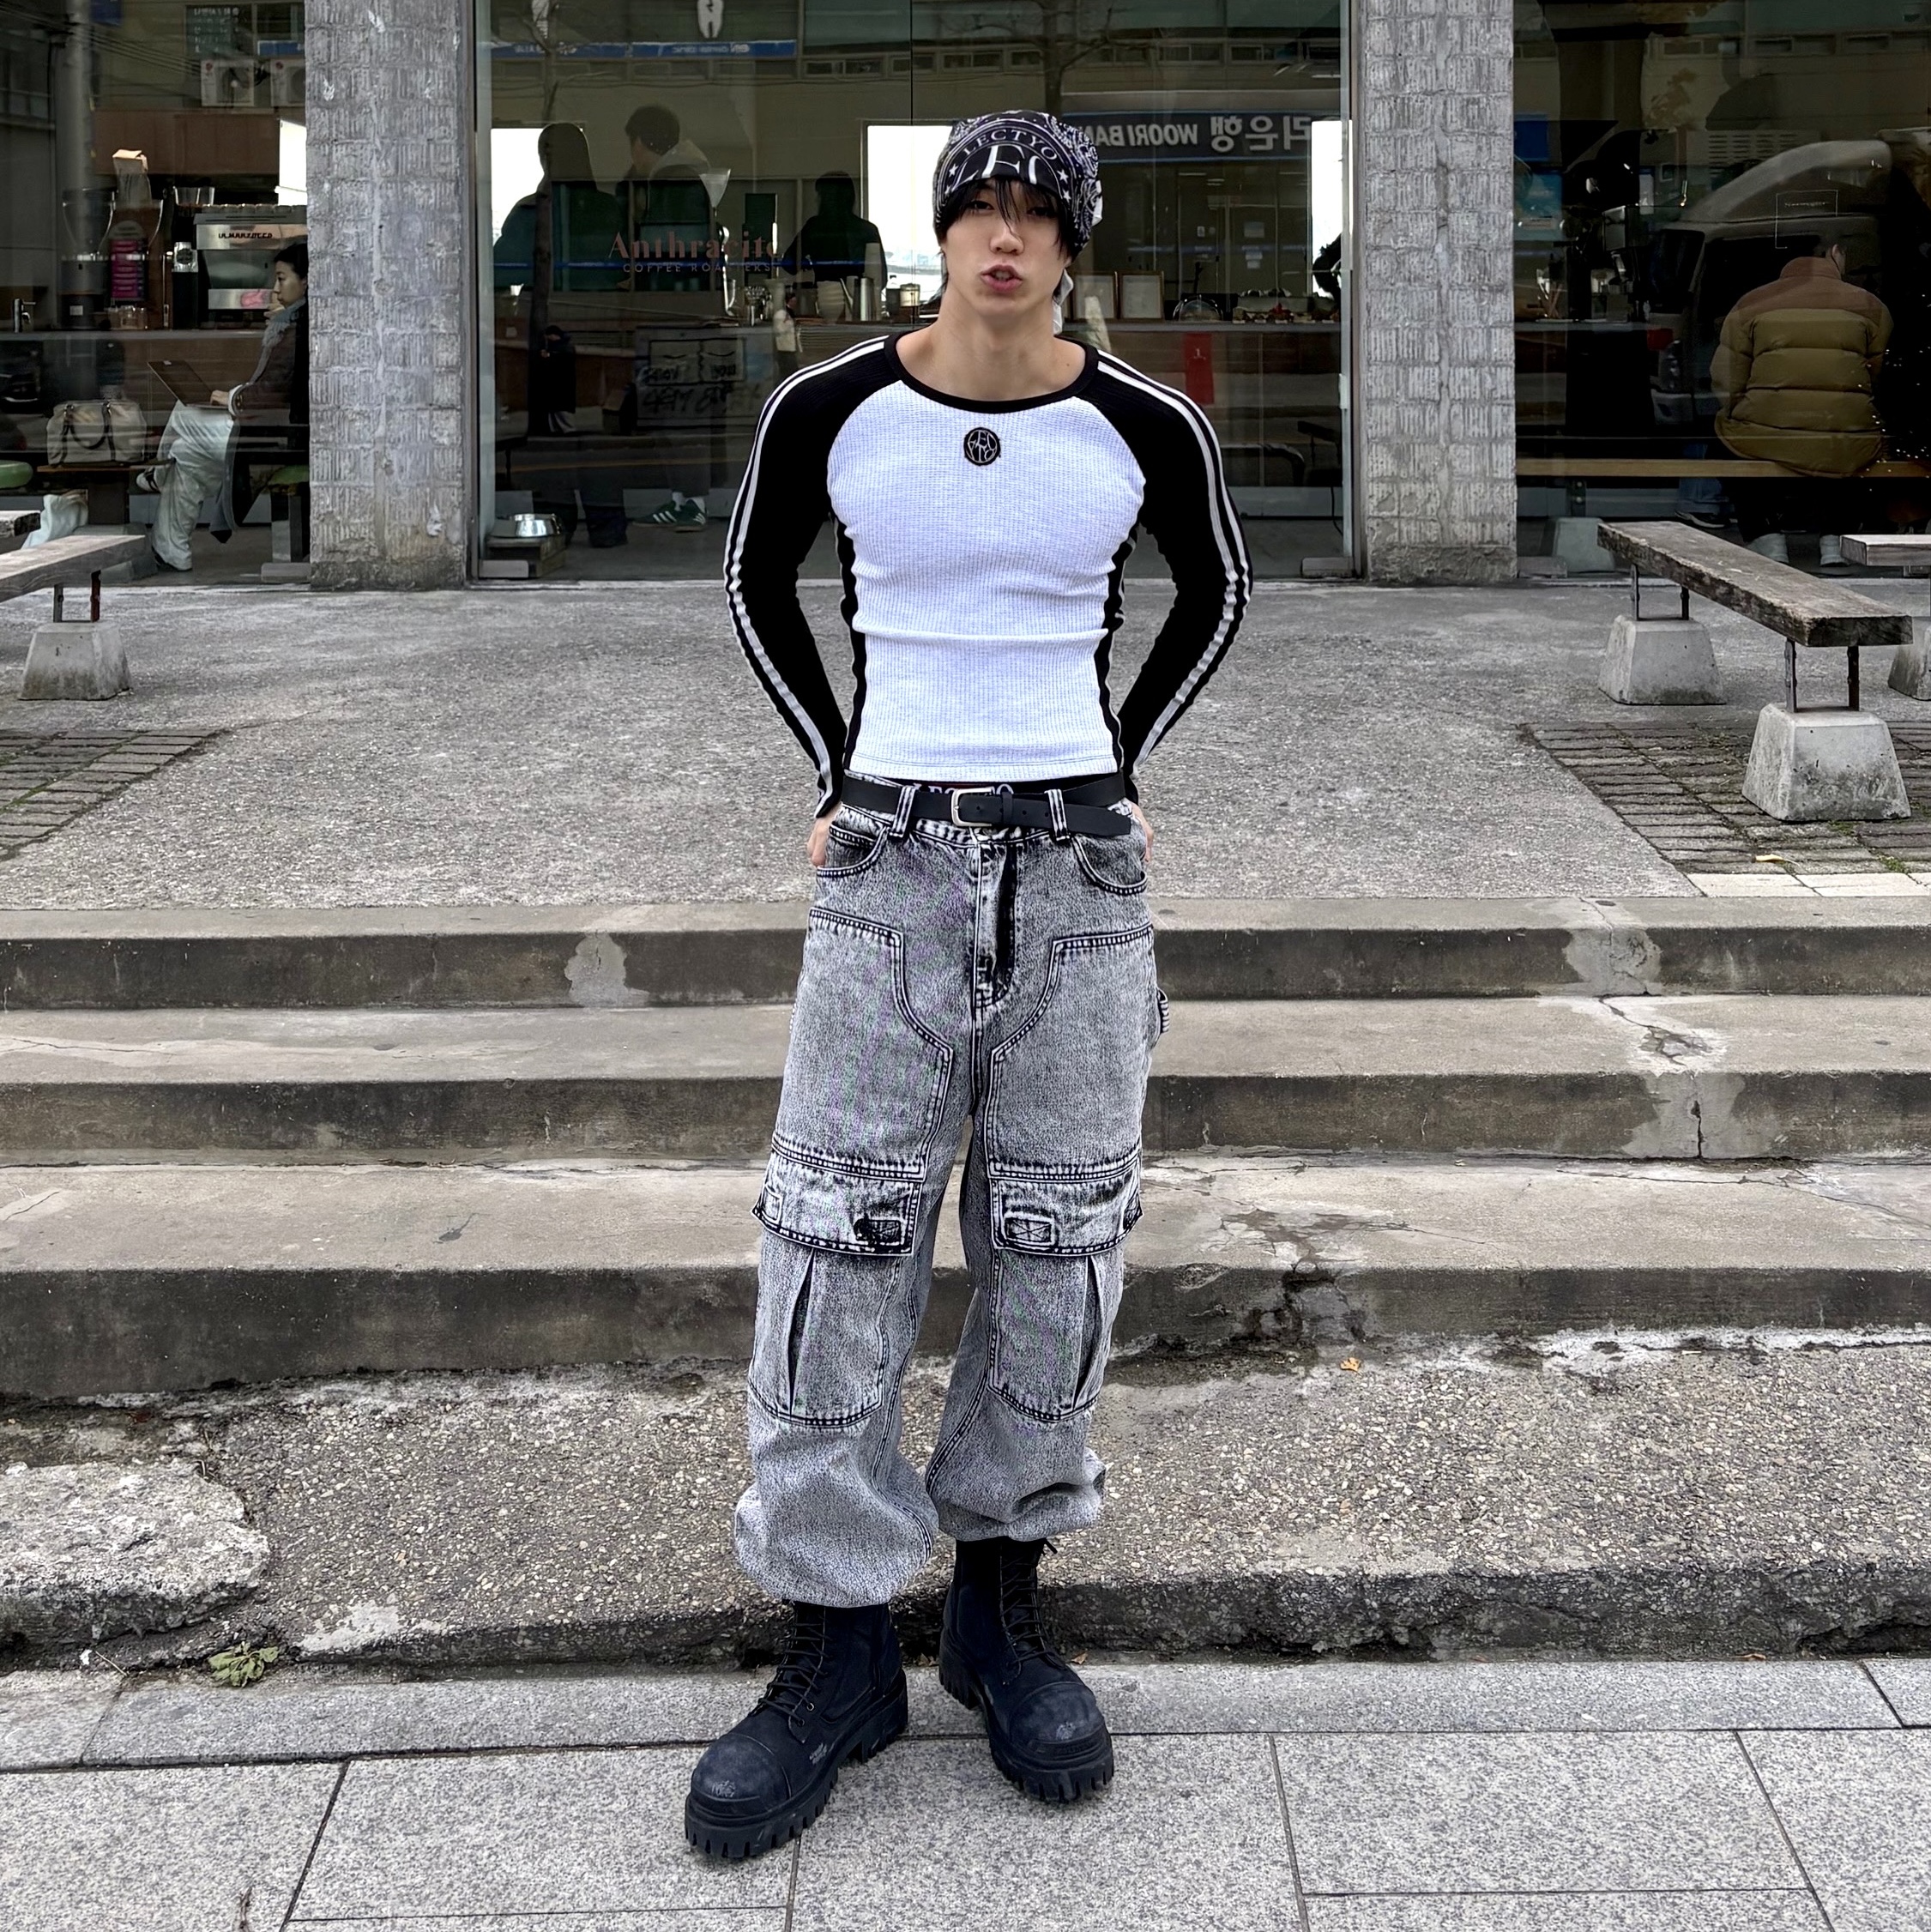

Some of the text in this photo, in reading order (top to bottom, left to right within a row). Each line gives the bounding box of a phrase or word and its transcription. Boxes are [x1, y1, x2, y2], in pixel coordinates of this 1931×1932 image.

[962, 129, 1058, 160] LECTYO
[623, 262, 770, 273] COFFEE ROAERS
